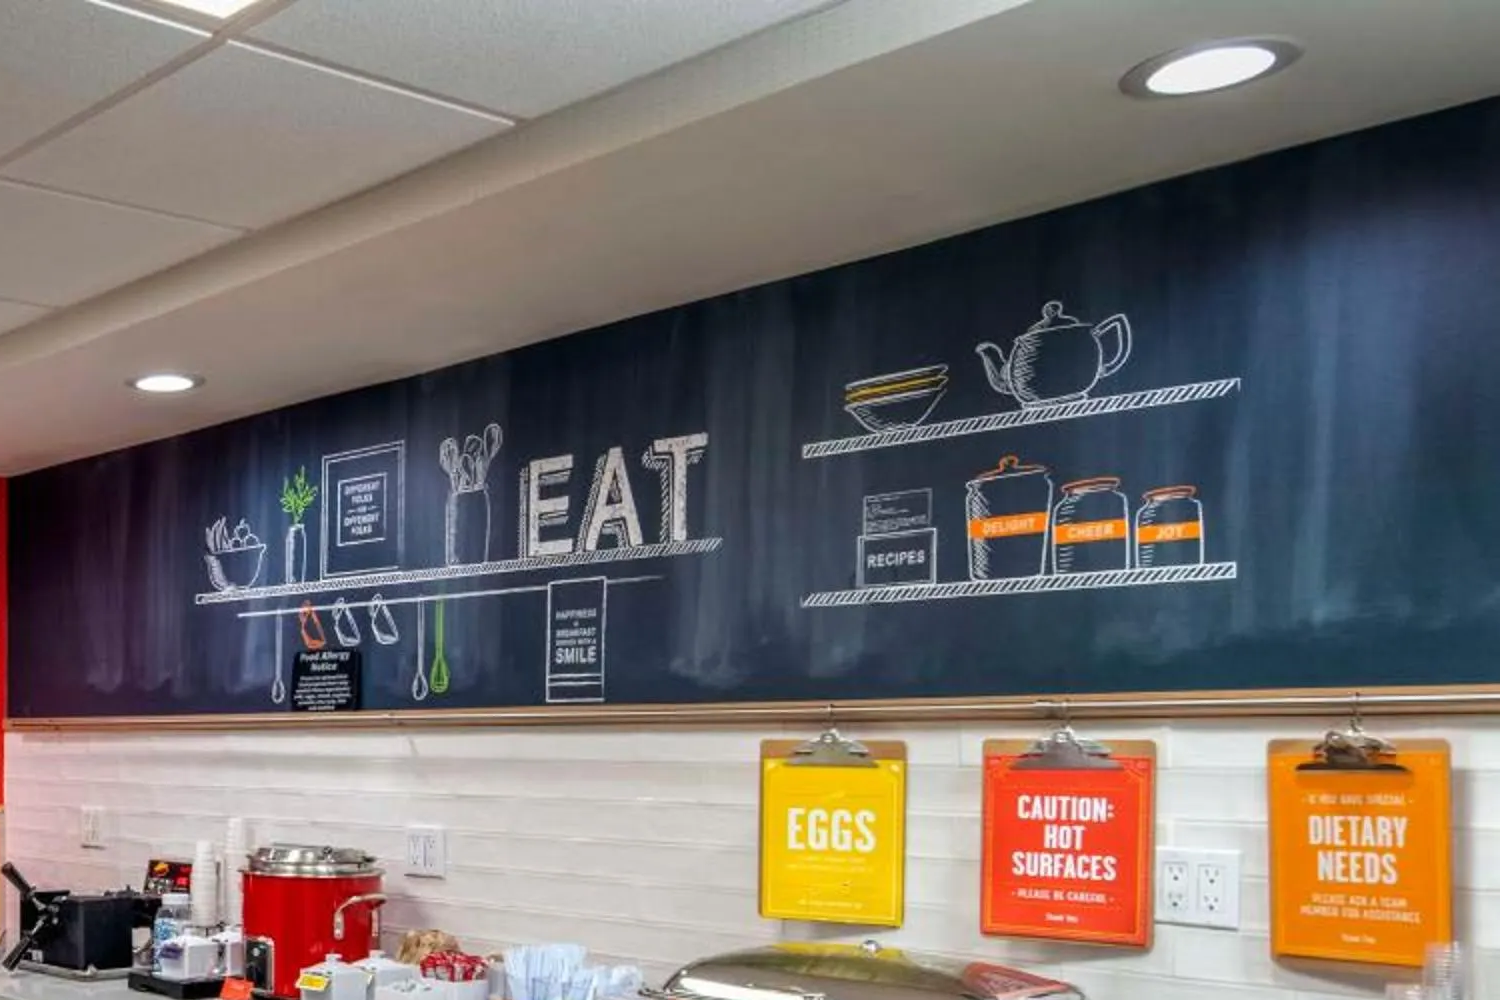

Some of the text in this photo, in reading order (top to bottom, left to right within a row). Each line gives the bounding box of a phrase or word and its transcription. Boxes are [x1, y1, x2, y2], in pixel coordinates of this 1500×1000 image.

[518, 431, 709, 561] EAT
[981, 517, 1036, 536] DELIGHT
[1066, 523, 1116, 539] CHEER
[1155, 525, 1186, 539] JOY
[867, 549, 926, 568] RECIPES
[556, 646, 597, 664] SMILE
[1017, 795, 1115, 823] CAUTION:
[787, 807, 876, 853] EGGS
[1044, 824, 1086, 851] HOT
[1308, 815, 1408, 849] DIETARY
[1012, 851, 1117, 881] SURFACES
[1317, 849, 1398, 885] NEEDS
